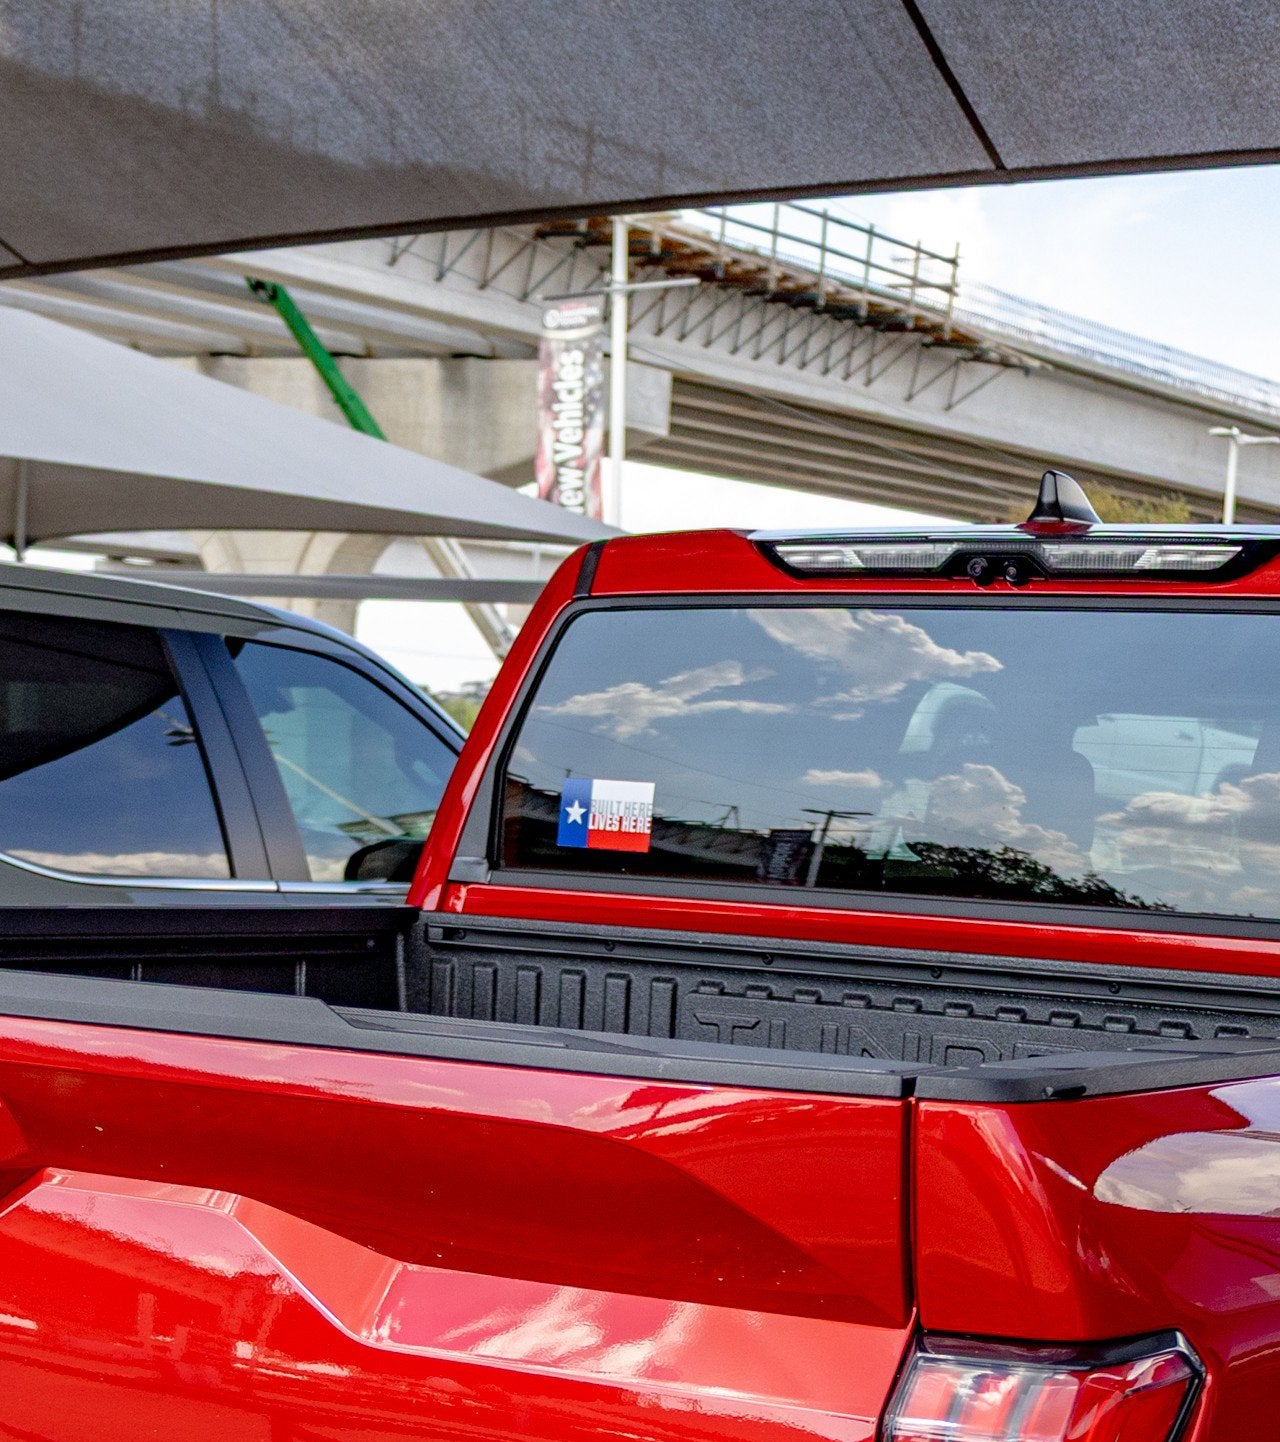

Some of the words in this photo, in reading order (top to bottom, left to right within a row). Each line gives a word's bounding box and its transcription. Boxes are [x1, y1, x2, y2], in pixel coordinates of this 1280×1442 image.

[552, 349, 585, 464] Vehicles
[590, 799, 621, 817] BUILT
[623, 801, 653, 819] HERE
[588, 813, 620, 832] LIVES
[620, 816, 652, 834] HERE
